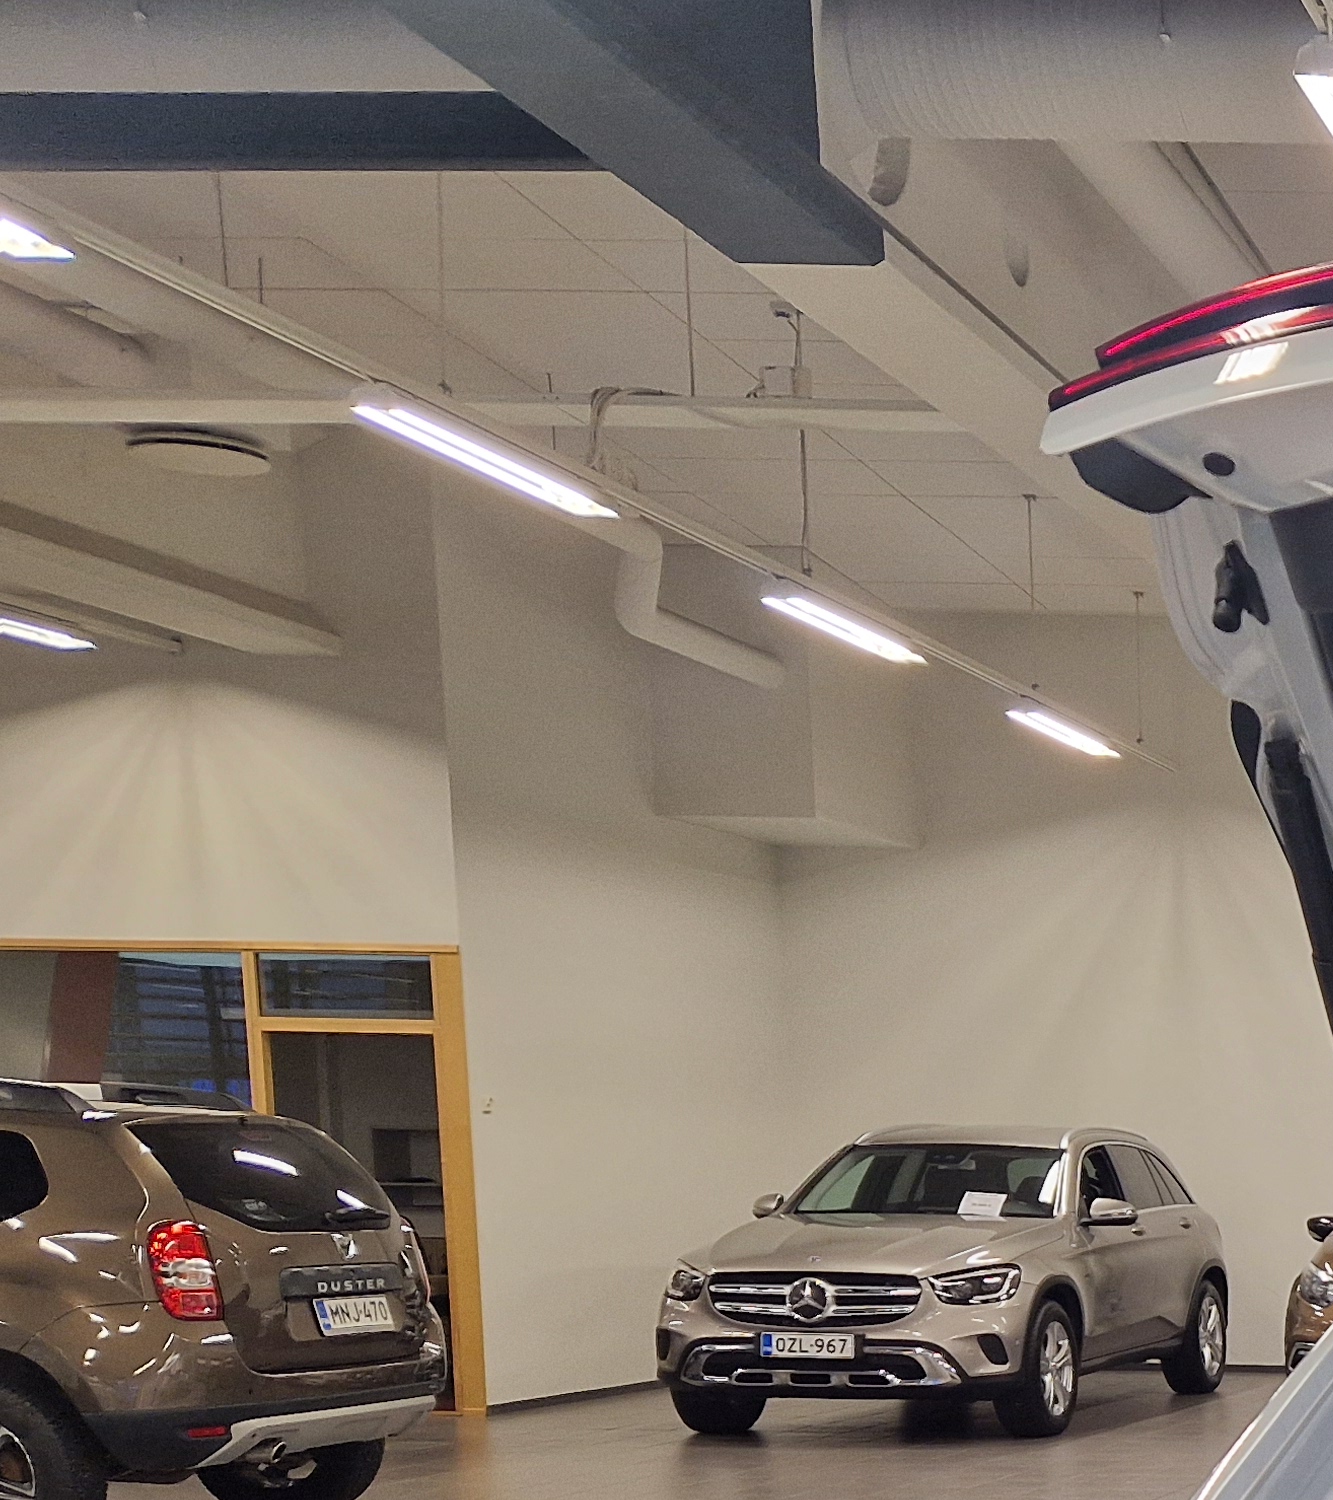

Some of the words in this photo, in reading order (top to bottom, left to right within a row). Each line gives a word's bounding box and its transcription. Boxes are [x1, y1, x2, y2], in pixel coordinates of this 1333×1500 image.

[317, 1278, 385, 1294] DUSTER
[328, 1300, 389, 1325] MNJ-470
[775, 1337, 848, 1355] OZL-967
